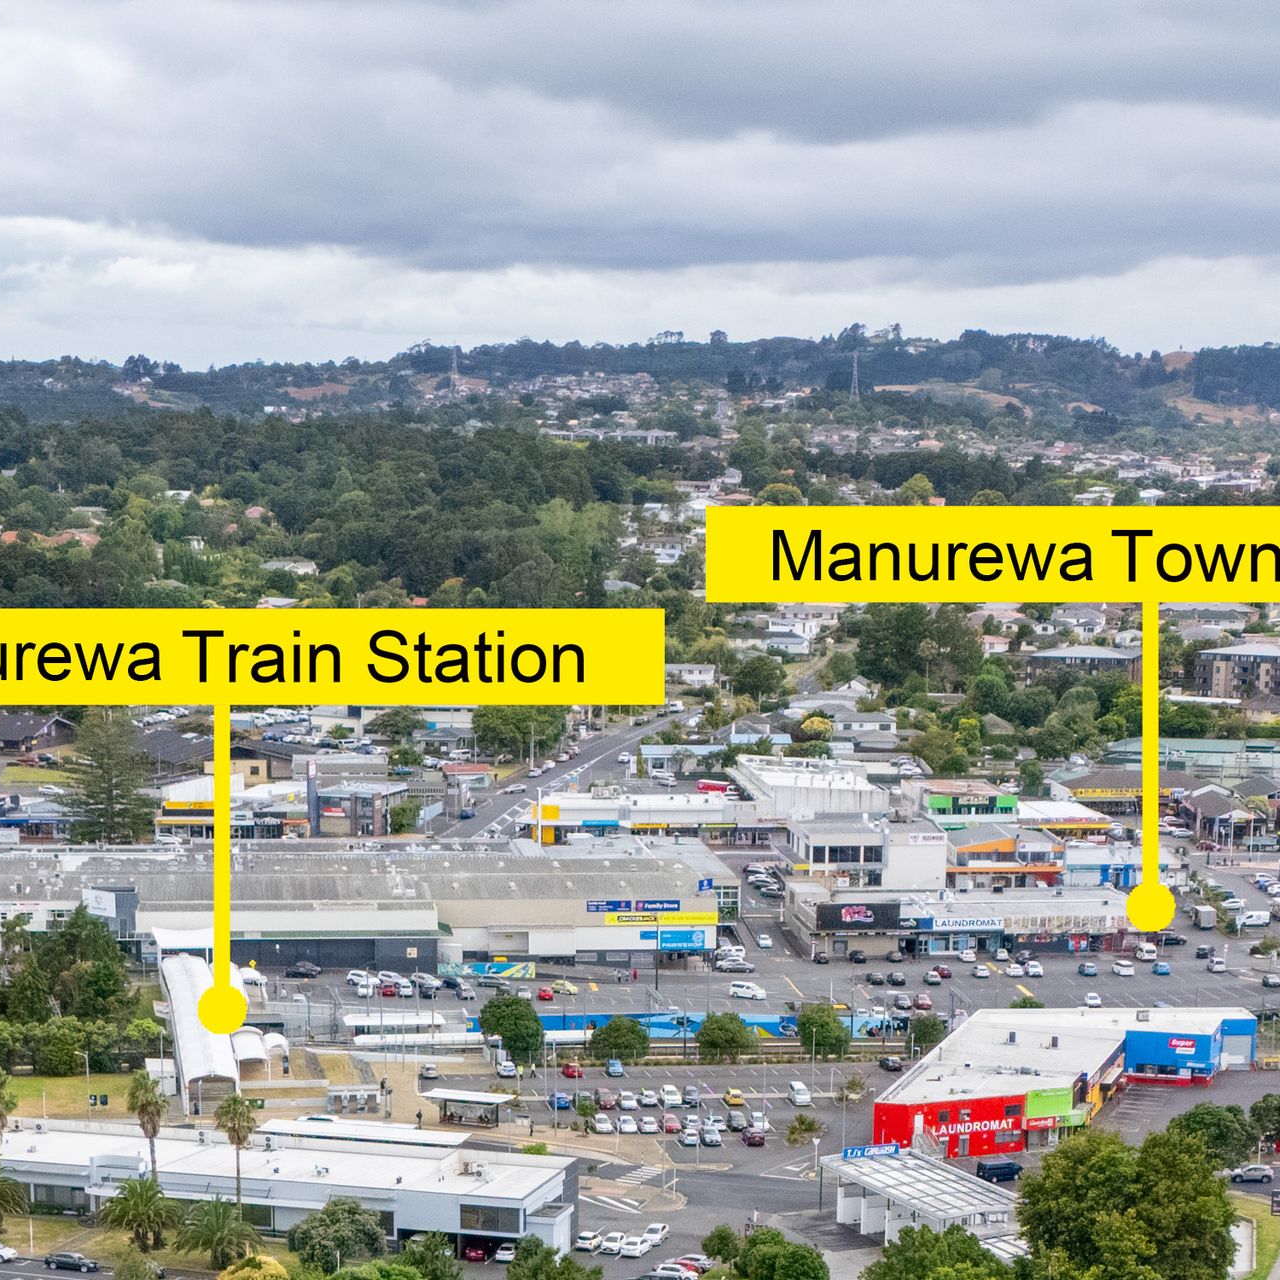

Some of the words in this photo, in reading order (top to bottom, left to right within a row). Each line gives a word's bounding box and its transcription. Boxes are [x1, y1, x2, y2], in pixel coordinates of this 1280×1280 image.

[935, 919, 1003, 928] LAUNDROMAT
[1171, 1038, 1194, 1047] Super
[932, 1118, 1014, 1136] LAUNDROMAT
